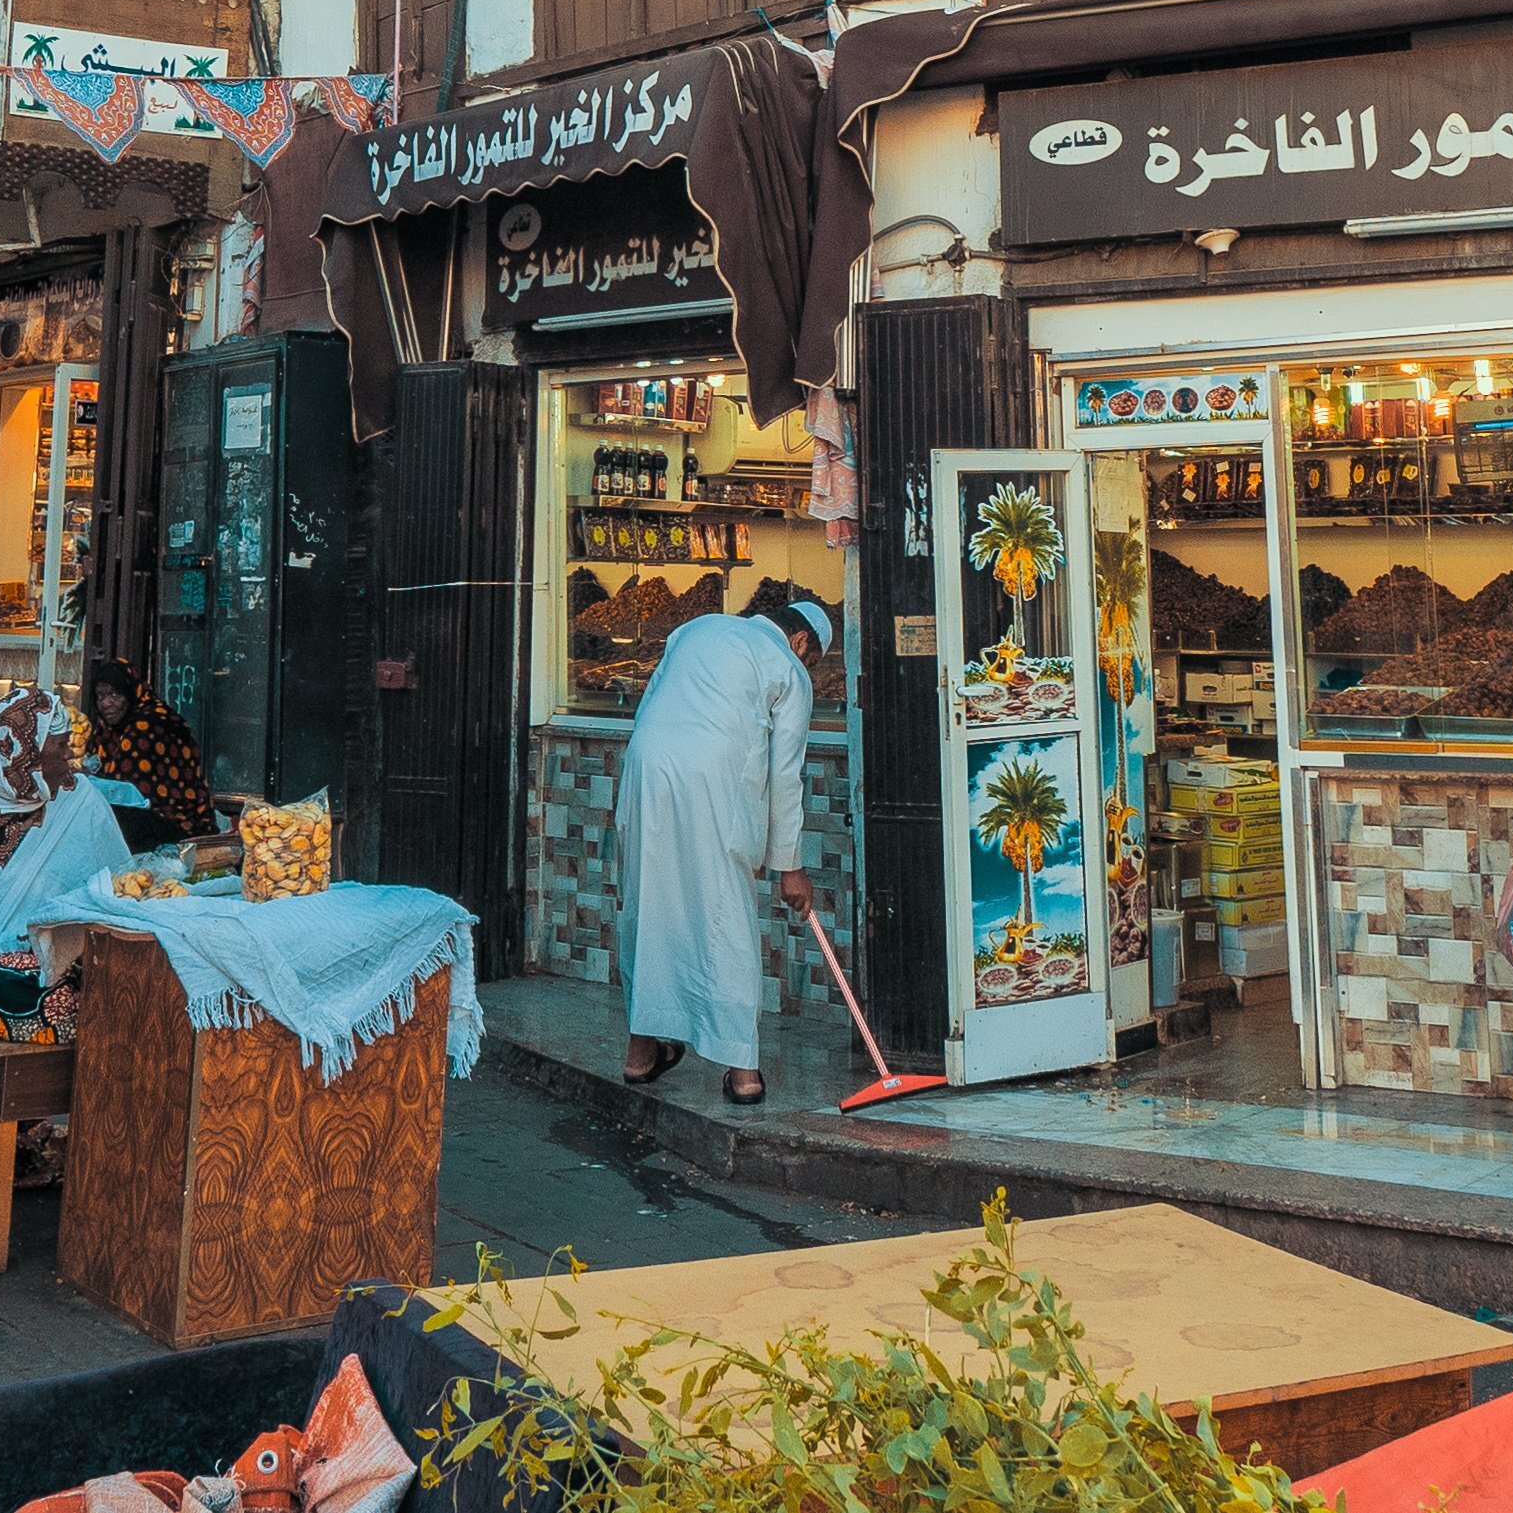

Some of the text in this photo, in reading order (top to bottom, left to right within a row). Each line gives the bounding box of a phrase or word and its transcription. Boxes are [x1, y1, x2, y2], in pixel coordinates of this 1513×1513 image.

[367, 70, 694, 206] مركز الخير للتمور الفاخرة
[1047, 127, 1107, 159] قطاعي
[1144, 104, 1378, 197] الفاخرة
[497, 246, 585, 303] الفاخرة
[586, 236, 660, 292] للتمور
